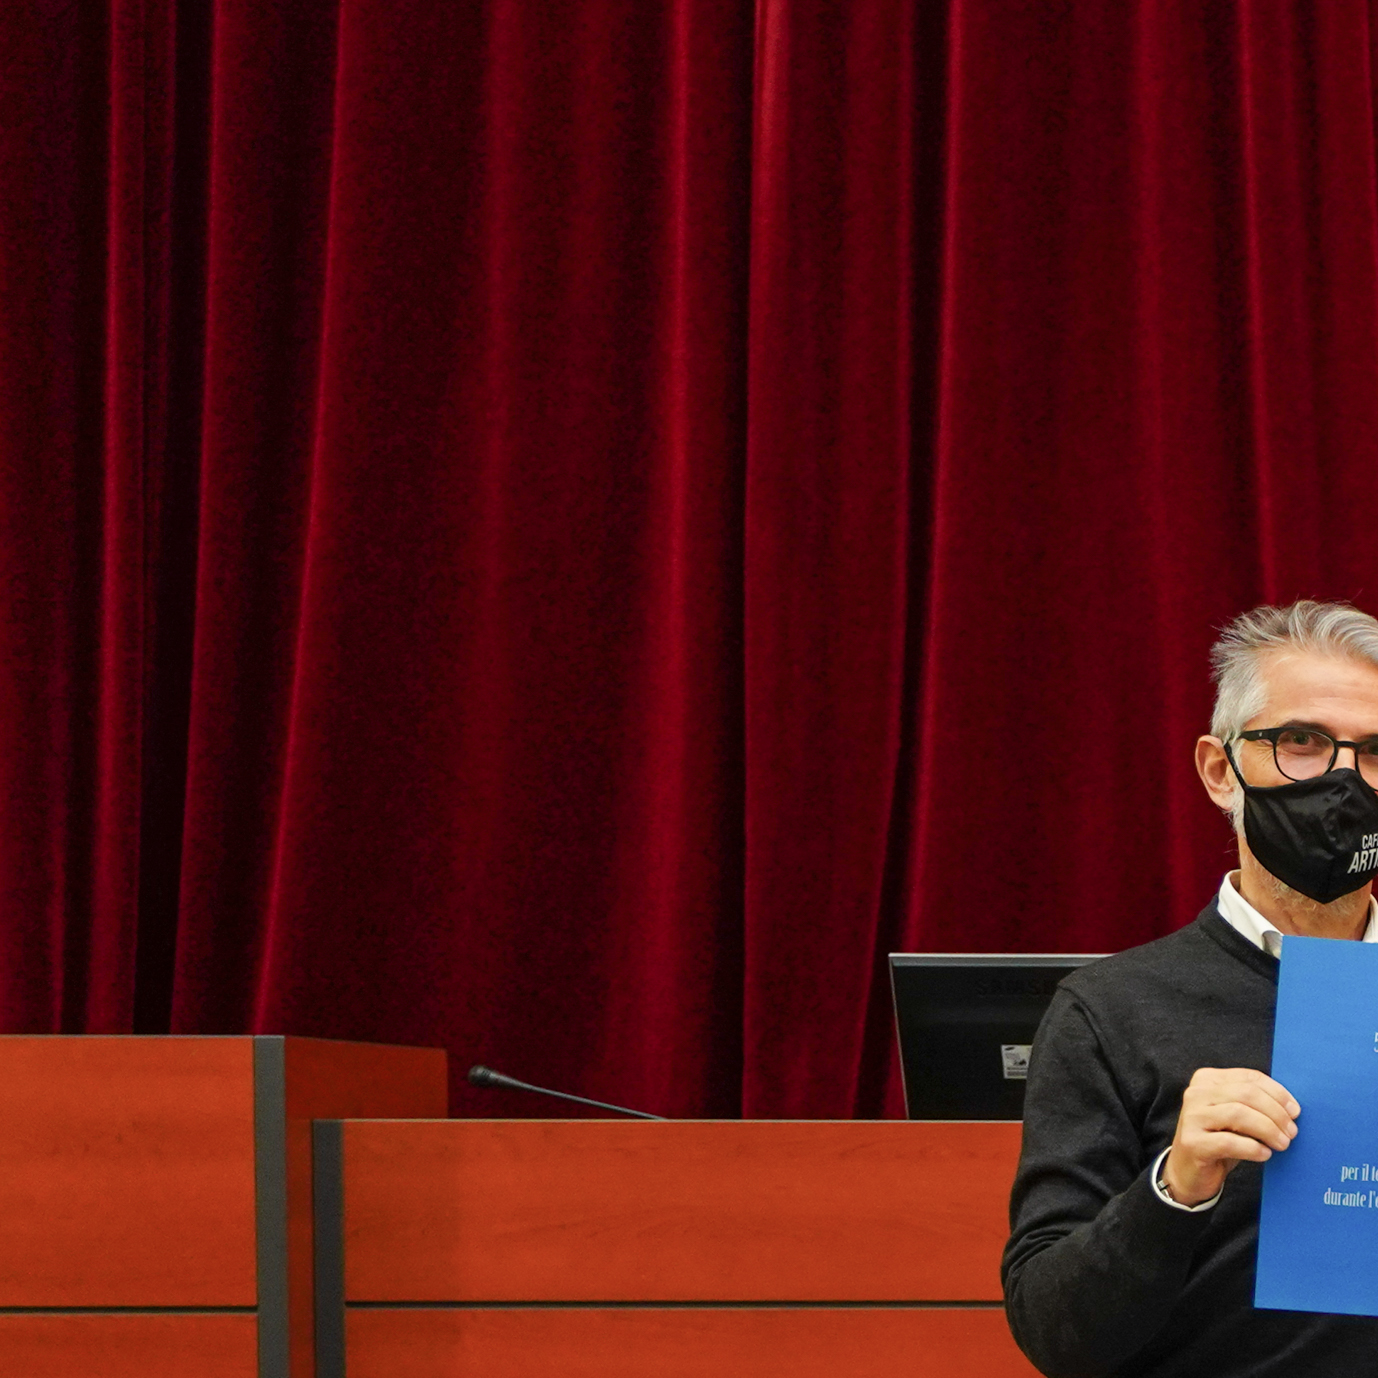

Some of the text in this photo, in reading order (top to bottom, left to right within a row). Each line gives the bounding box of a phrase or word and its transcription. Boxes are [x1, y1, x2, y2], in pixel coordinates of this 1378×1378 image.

[1341, 1165, 1360, 1183] per
[1362, 1164, 1370, 1181] il
[1323, 1187, 1367, 1208] durante
